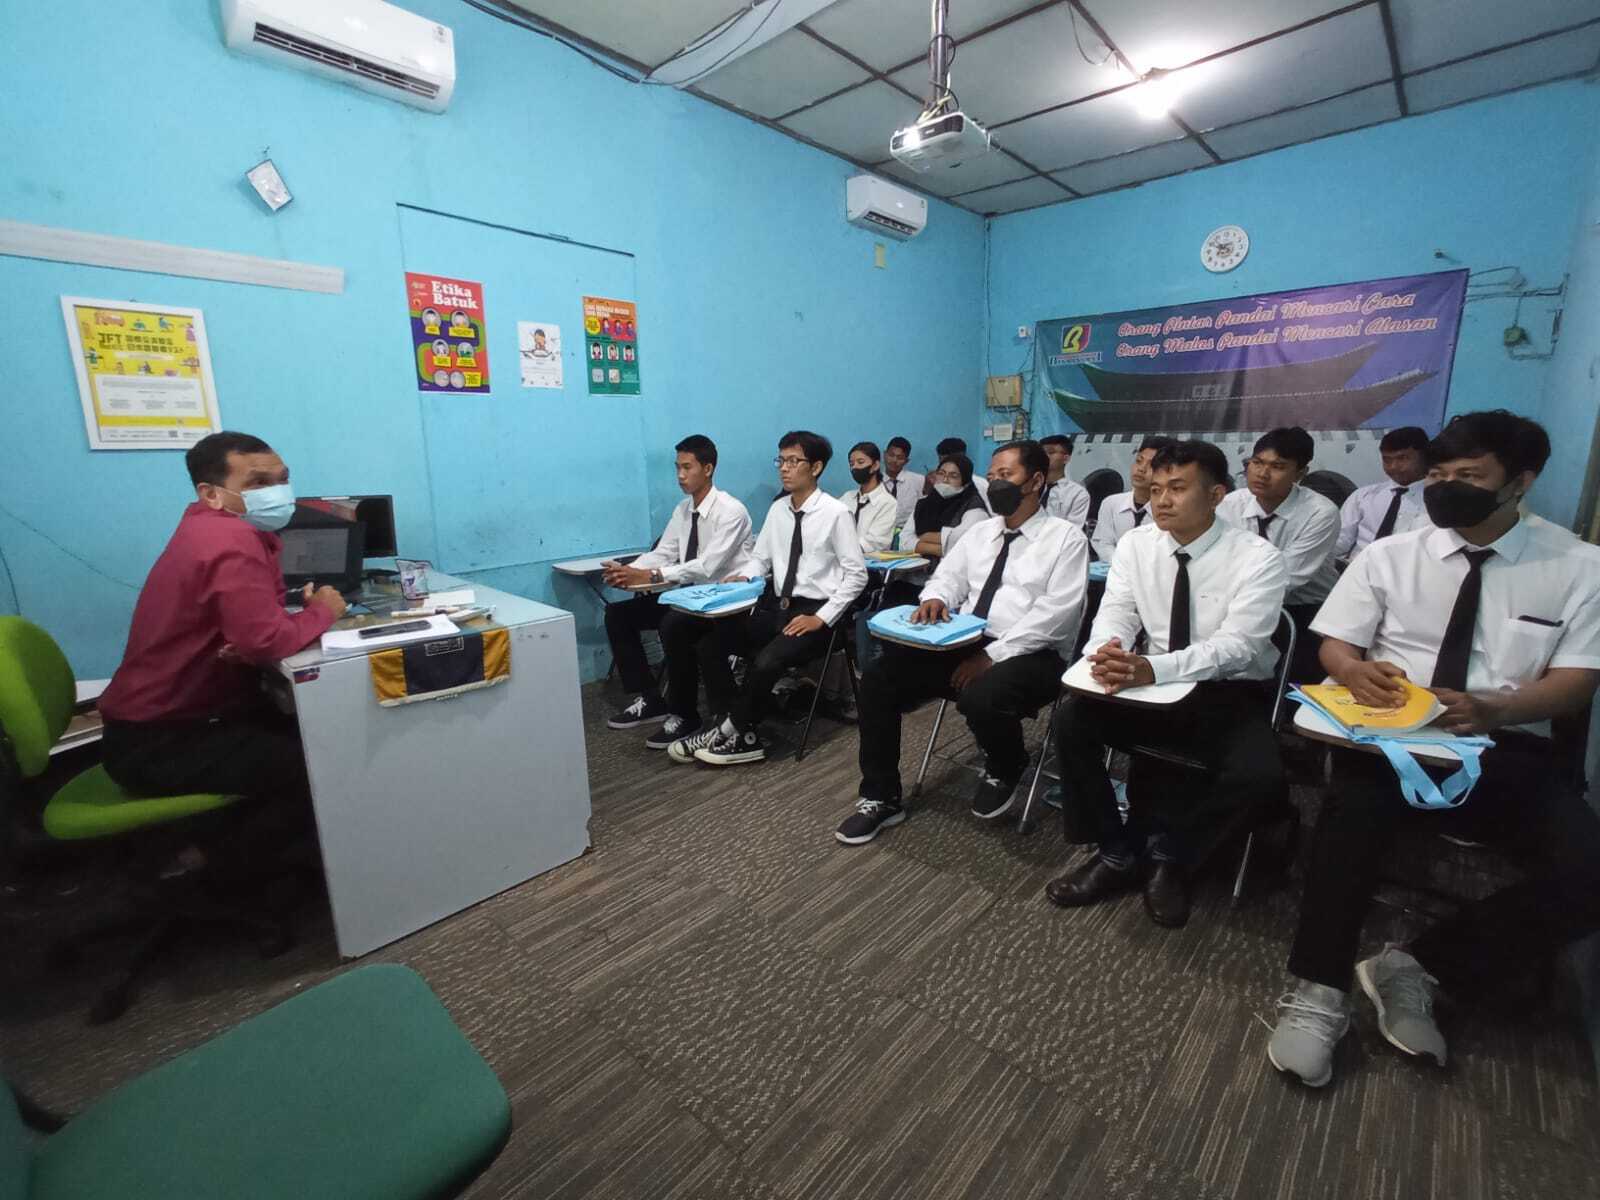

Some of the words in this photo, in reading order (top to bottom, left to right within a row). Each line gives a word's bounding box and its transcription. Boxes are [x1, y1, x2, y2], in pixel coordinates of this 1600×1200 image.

[431, 281, 472, 298] Etika
[433, 293, 478, 309] Batuk
[1118, 321, 1162, 337] Orang
[1214, 304, 1277, 329] Pandai
[1280, 294, 1362, 320] Mencari
[1361, 292, 1416, 315] Cara
[97, 332, 122, 344] JFT
[1116, 342, 1160, 358] Orang
[1163, 336, 1214, 354] Malas
[1217, 327, 1279, 351] Pandai
[1281, 319, 1364, 343] Mencari
[1365, 317, 1438, 335] Alasan
